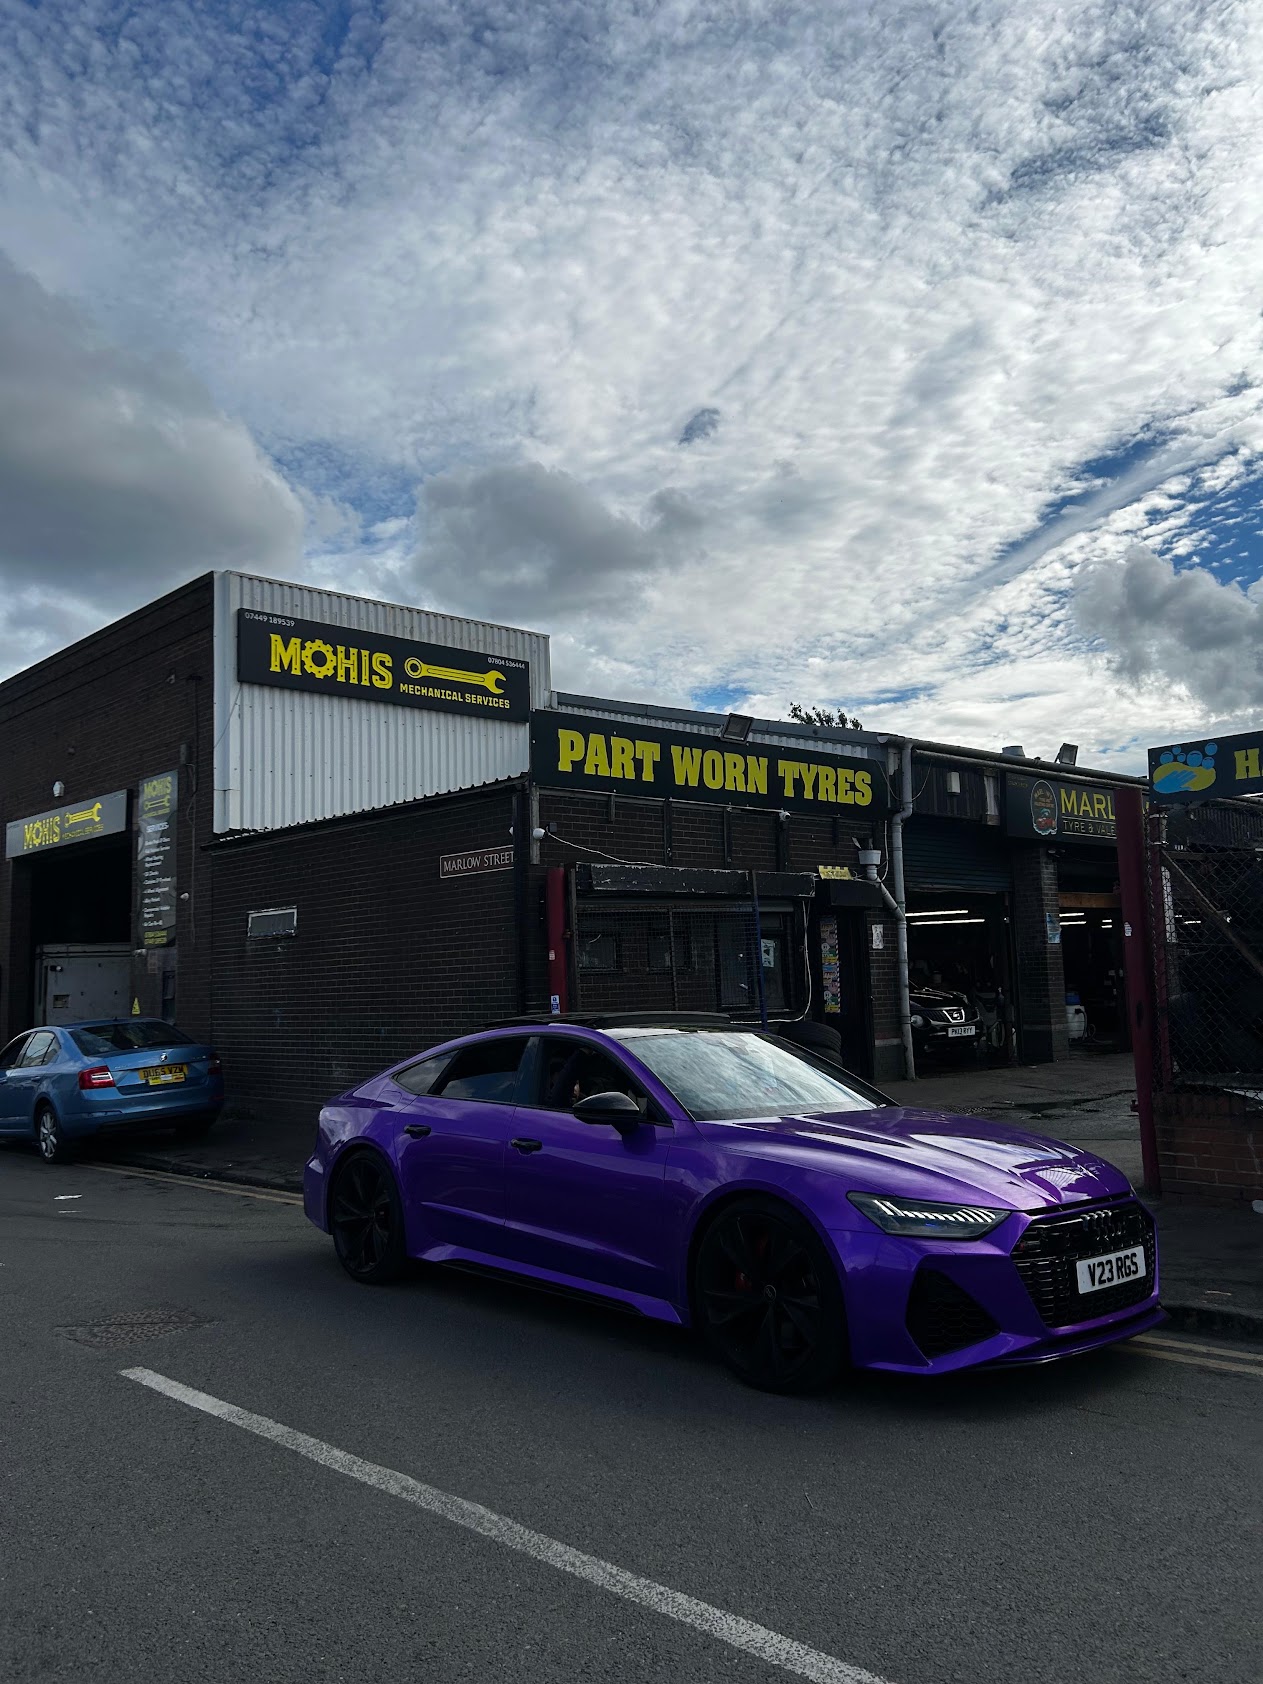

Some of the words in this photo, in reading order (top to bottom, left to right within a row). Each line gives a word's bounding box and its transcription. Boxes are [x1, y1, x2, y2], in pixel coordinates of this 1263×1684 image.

[244, 611, 268, 622] 07449
[269, 616, 295, 627] 189539
[269, 633, 393, 689] MOHIS
[487, 656, 505, 666] 07804
[505, 660, 525, 669] 536444
[399, 683, 463, 702] MECHANICAL
[464, 693, 510, 709] SERVICES
[557, 728, 661, 782] PART
[670, 745, 768, 795] WORN
[777, 759, 872, 806] TYRES
[1234, 747, 1263, 780] H
[1060, 788, 1116, 820] MARL
[23, 815, 61, 850] MOHIS
[1063, 820, 1086, 833] TYRE
[1088, 825, 1094, 833] &
[1096, 824, 1116, 836] VALE
[443, 856, 481, 872] MARLOW
[483, 851, 514, 867] STREET
[1087, 1259, 1114, 1286] V23
[1115, 1252, 1138, 1280] RGS
